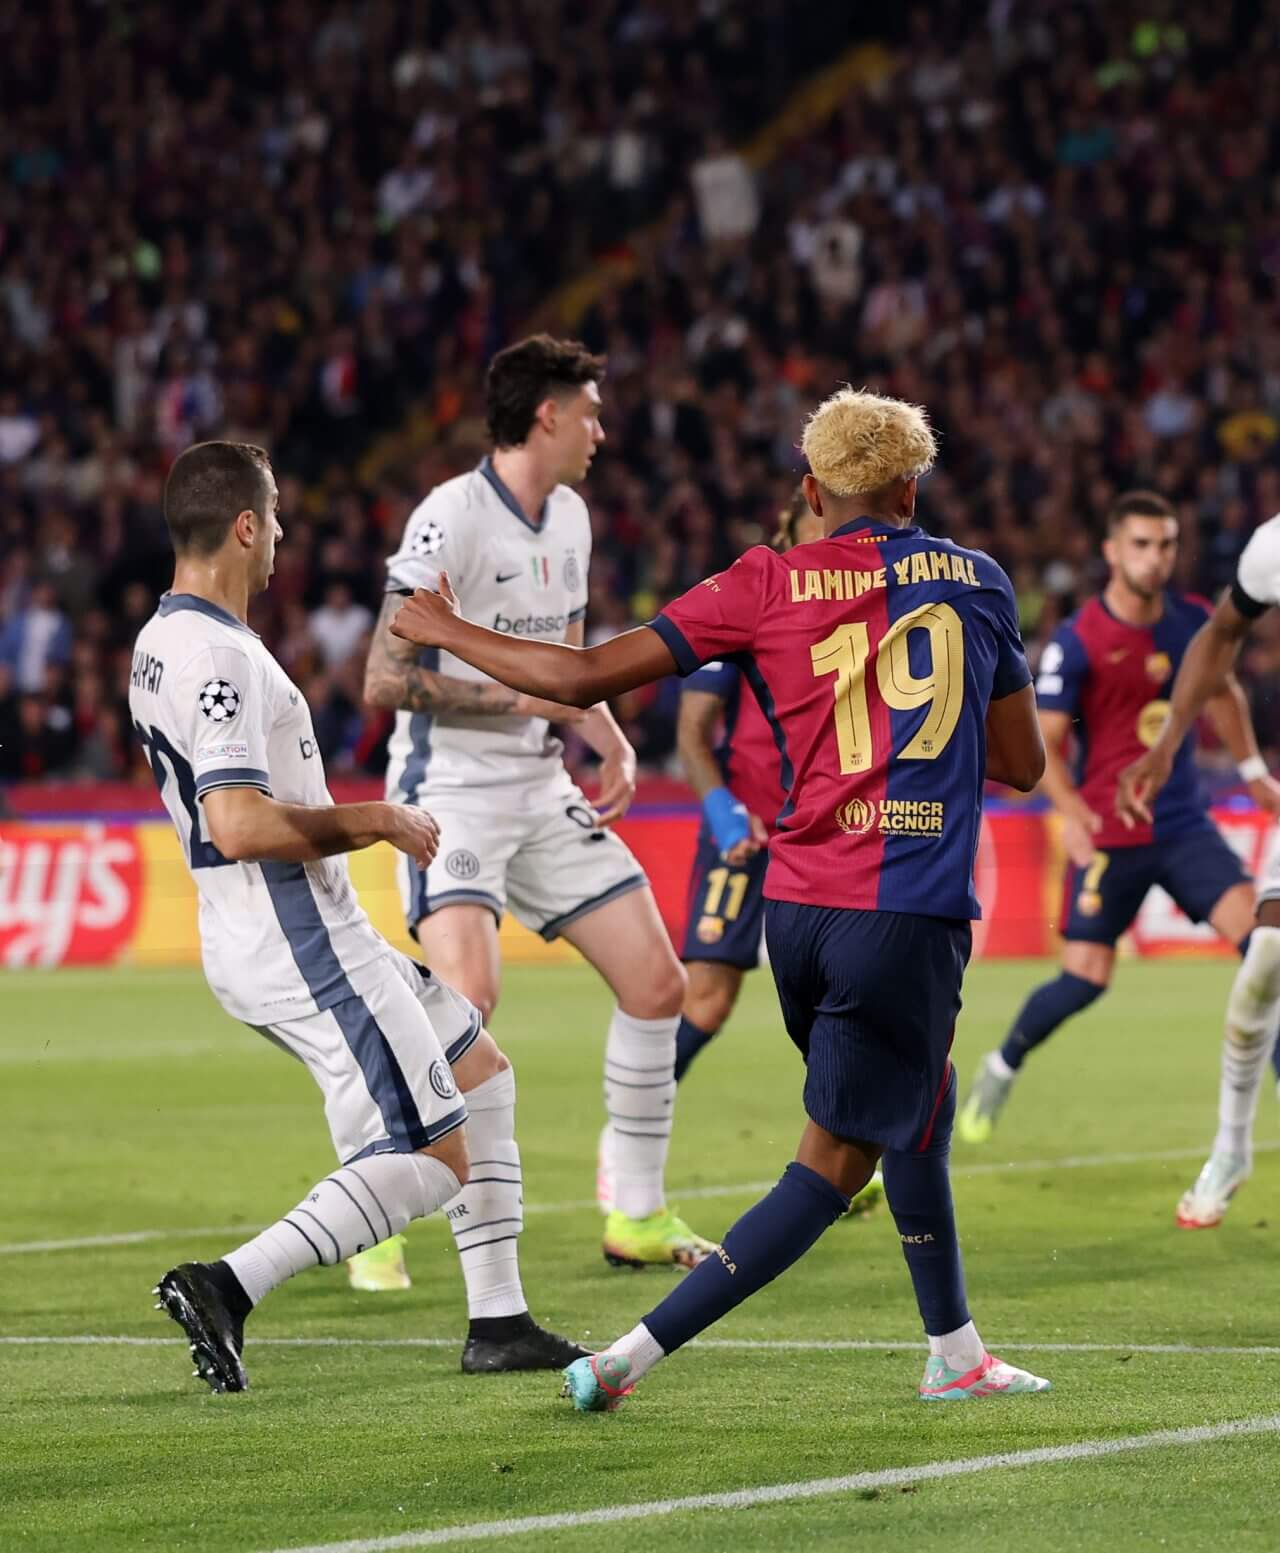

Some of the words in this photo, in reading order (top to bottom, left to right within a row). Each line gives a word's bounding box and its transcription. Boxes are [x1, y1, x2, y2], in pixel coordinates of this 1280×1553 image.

[790, 567, 888, 603] LAMINE
[893, 551, 981, 587] YAMAL
[810, 601, 965, 776] 19
[878, 815, 943, 831] ACNUR
[879, 800, 944, 817] UNHCR
[704, 866, 749, 920] 11
